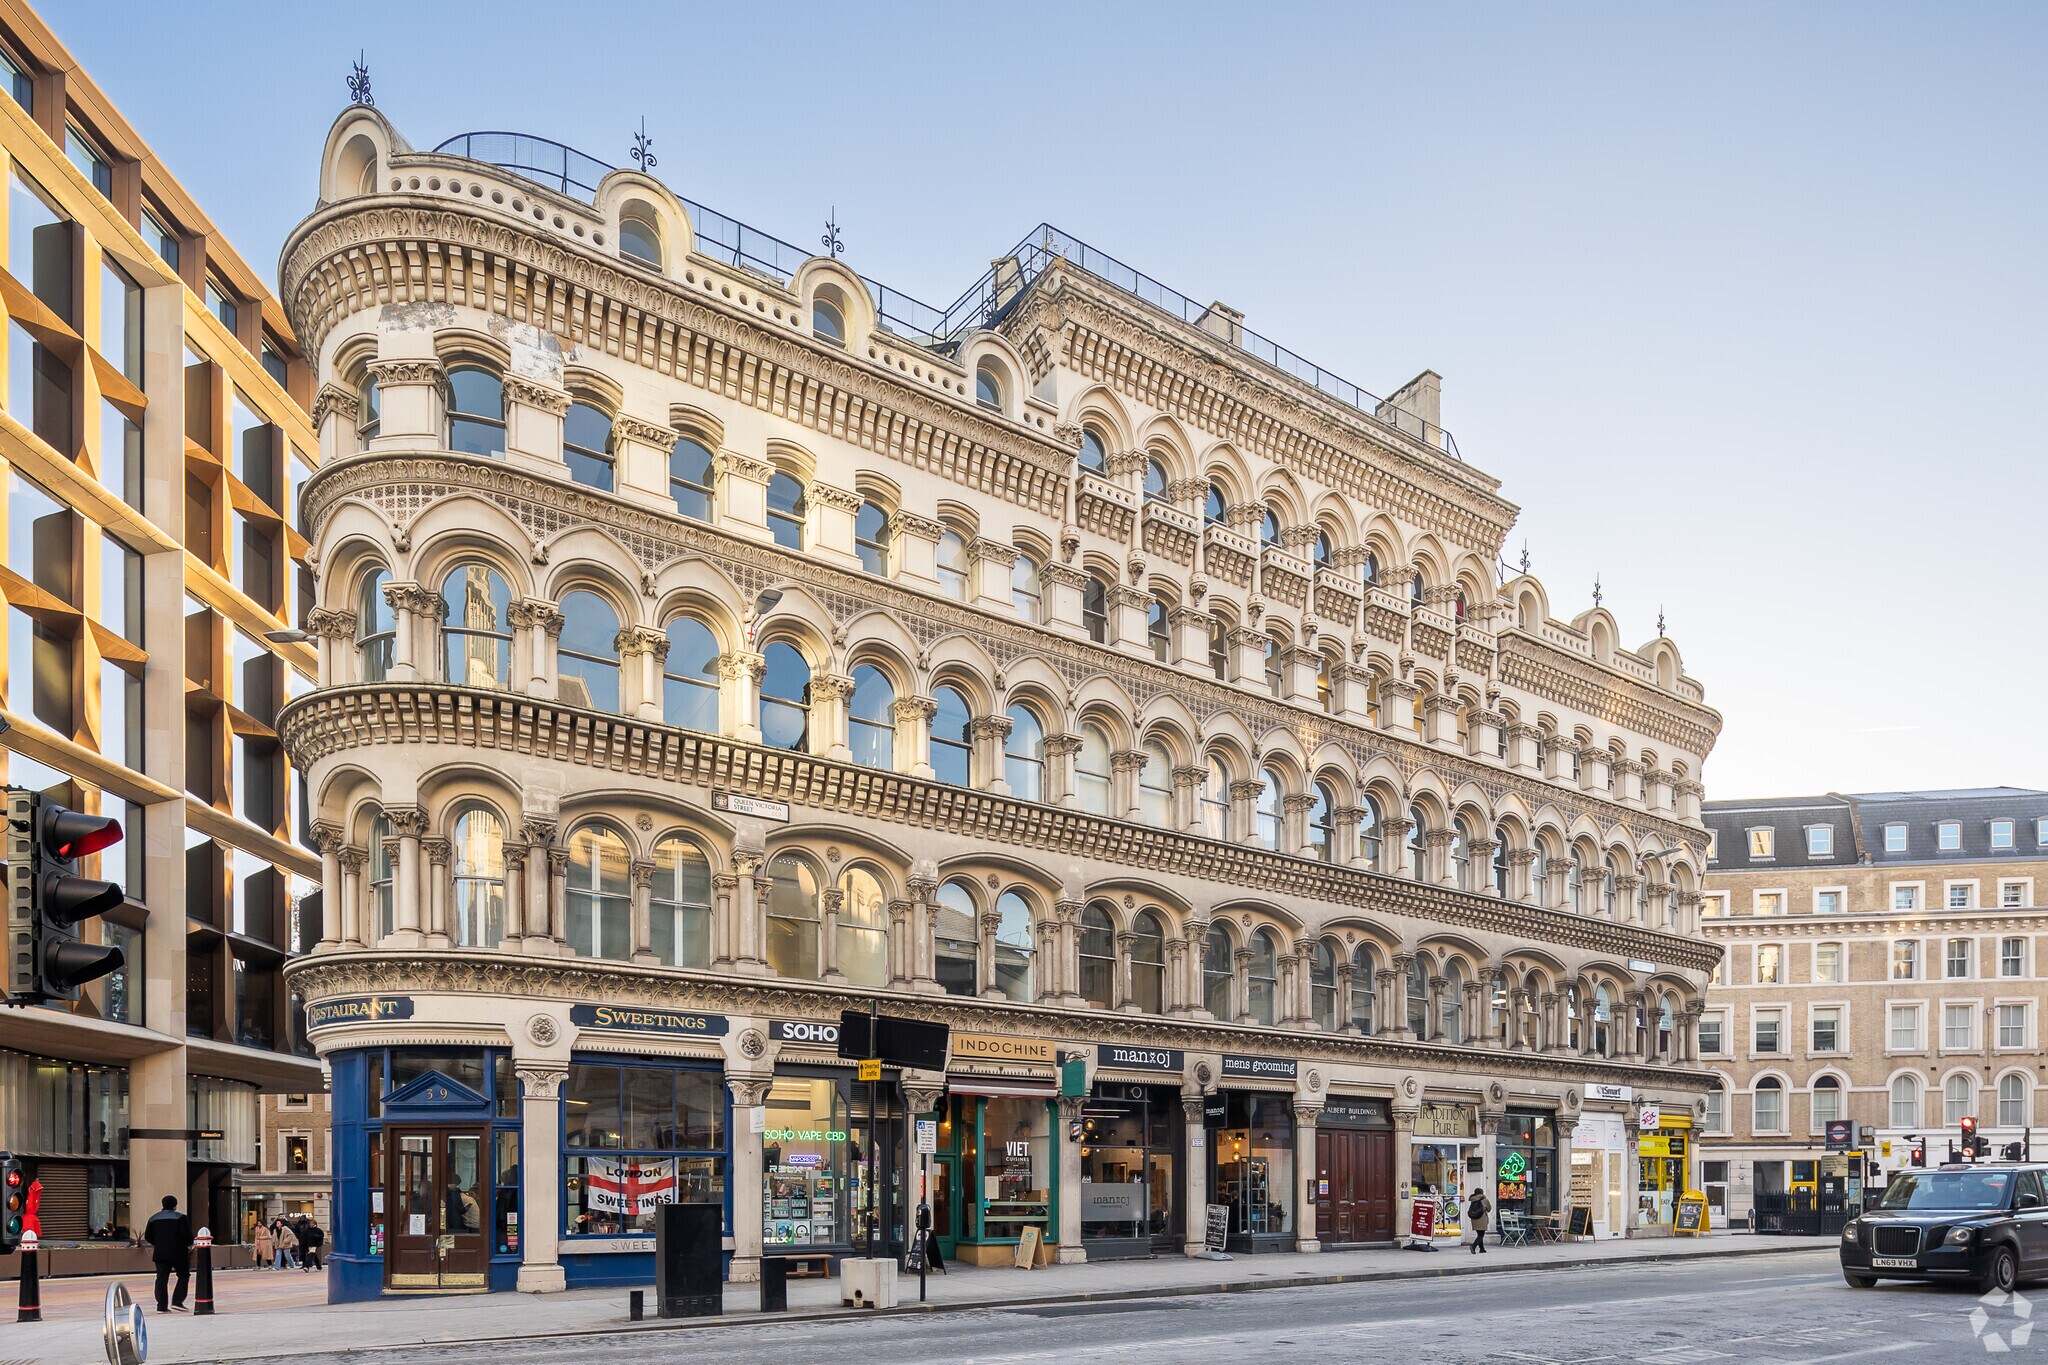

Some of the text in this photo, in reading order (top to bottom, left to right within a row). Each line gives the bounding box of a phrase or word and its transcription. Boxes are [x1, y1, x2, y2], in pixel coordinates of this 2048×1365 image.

[733, 798, 782, 811] QUEEN VICTORIA
[733, 804, 753, 812] STREET
[310, 1001, 399, 1026] RESTAURANT
[594, 1007, 707, 1030] SWEETINGS
[782, 1023, 838, 1042] SOHO
[960, 1039, 1047, 1057] INDOCHINE
[1225, 1059, 1295, 1075] mens grooming
[1327, 1106, 1377, 1116] ALBERT BUILDINGS
[1420, 1106, 1476, 1121] TRADITIONAL
[1432, 1119, 1459, 1135] PURE
[764, 1129, 847, 1141] SOHO VAPE CBD
[1006, 1141, 1030, 1156] VIET
[606, 1166, 662, 1178] LONDON
[597, 1194, 672, 1209] SWEETINGS
[1876, 1259, 1897, 1267] LN69
